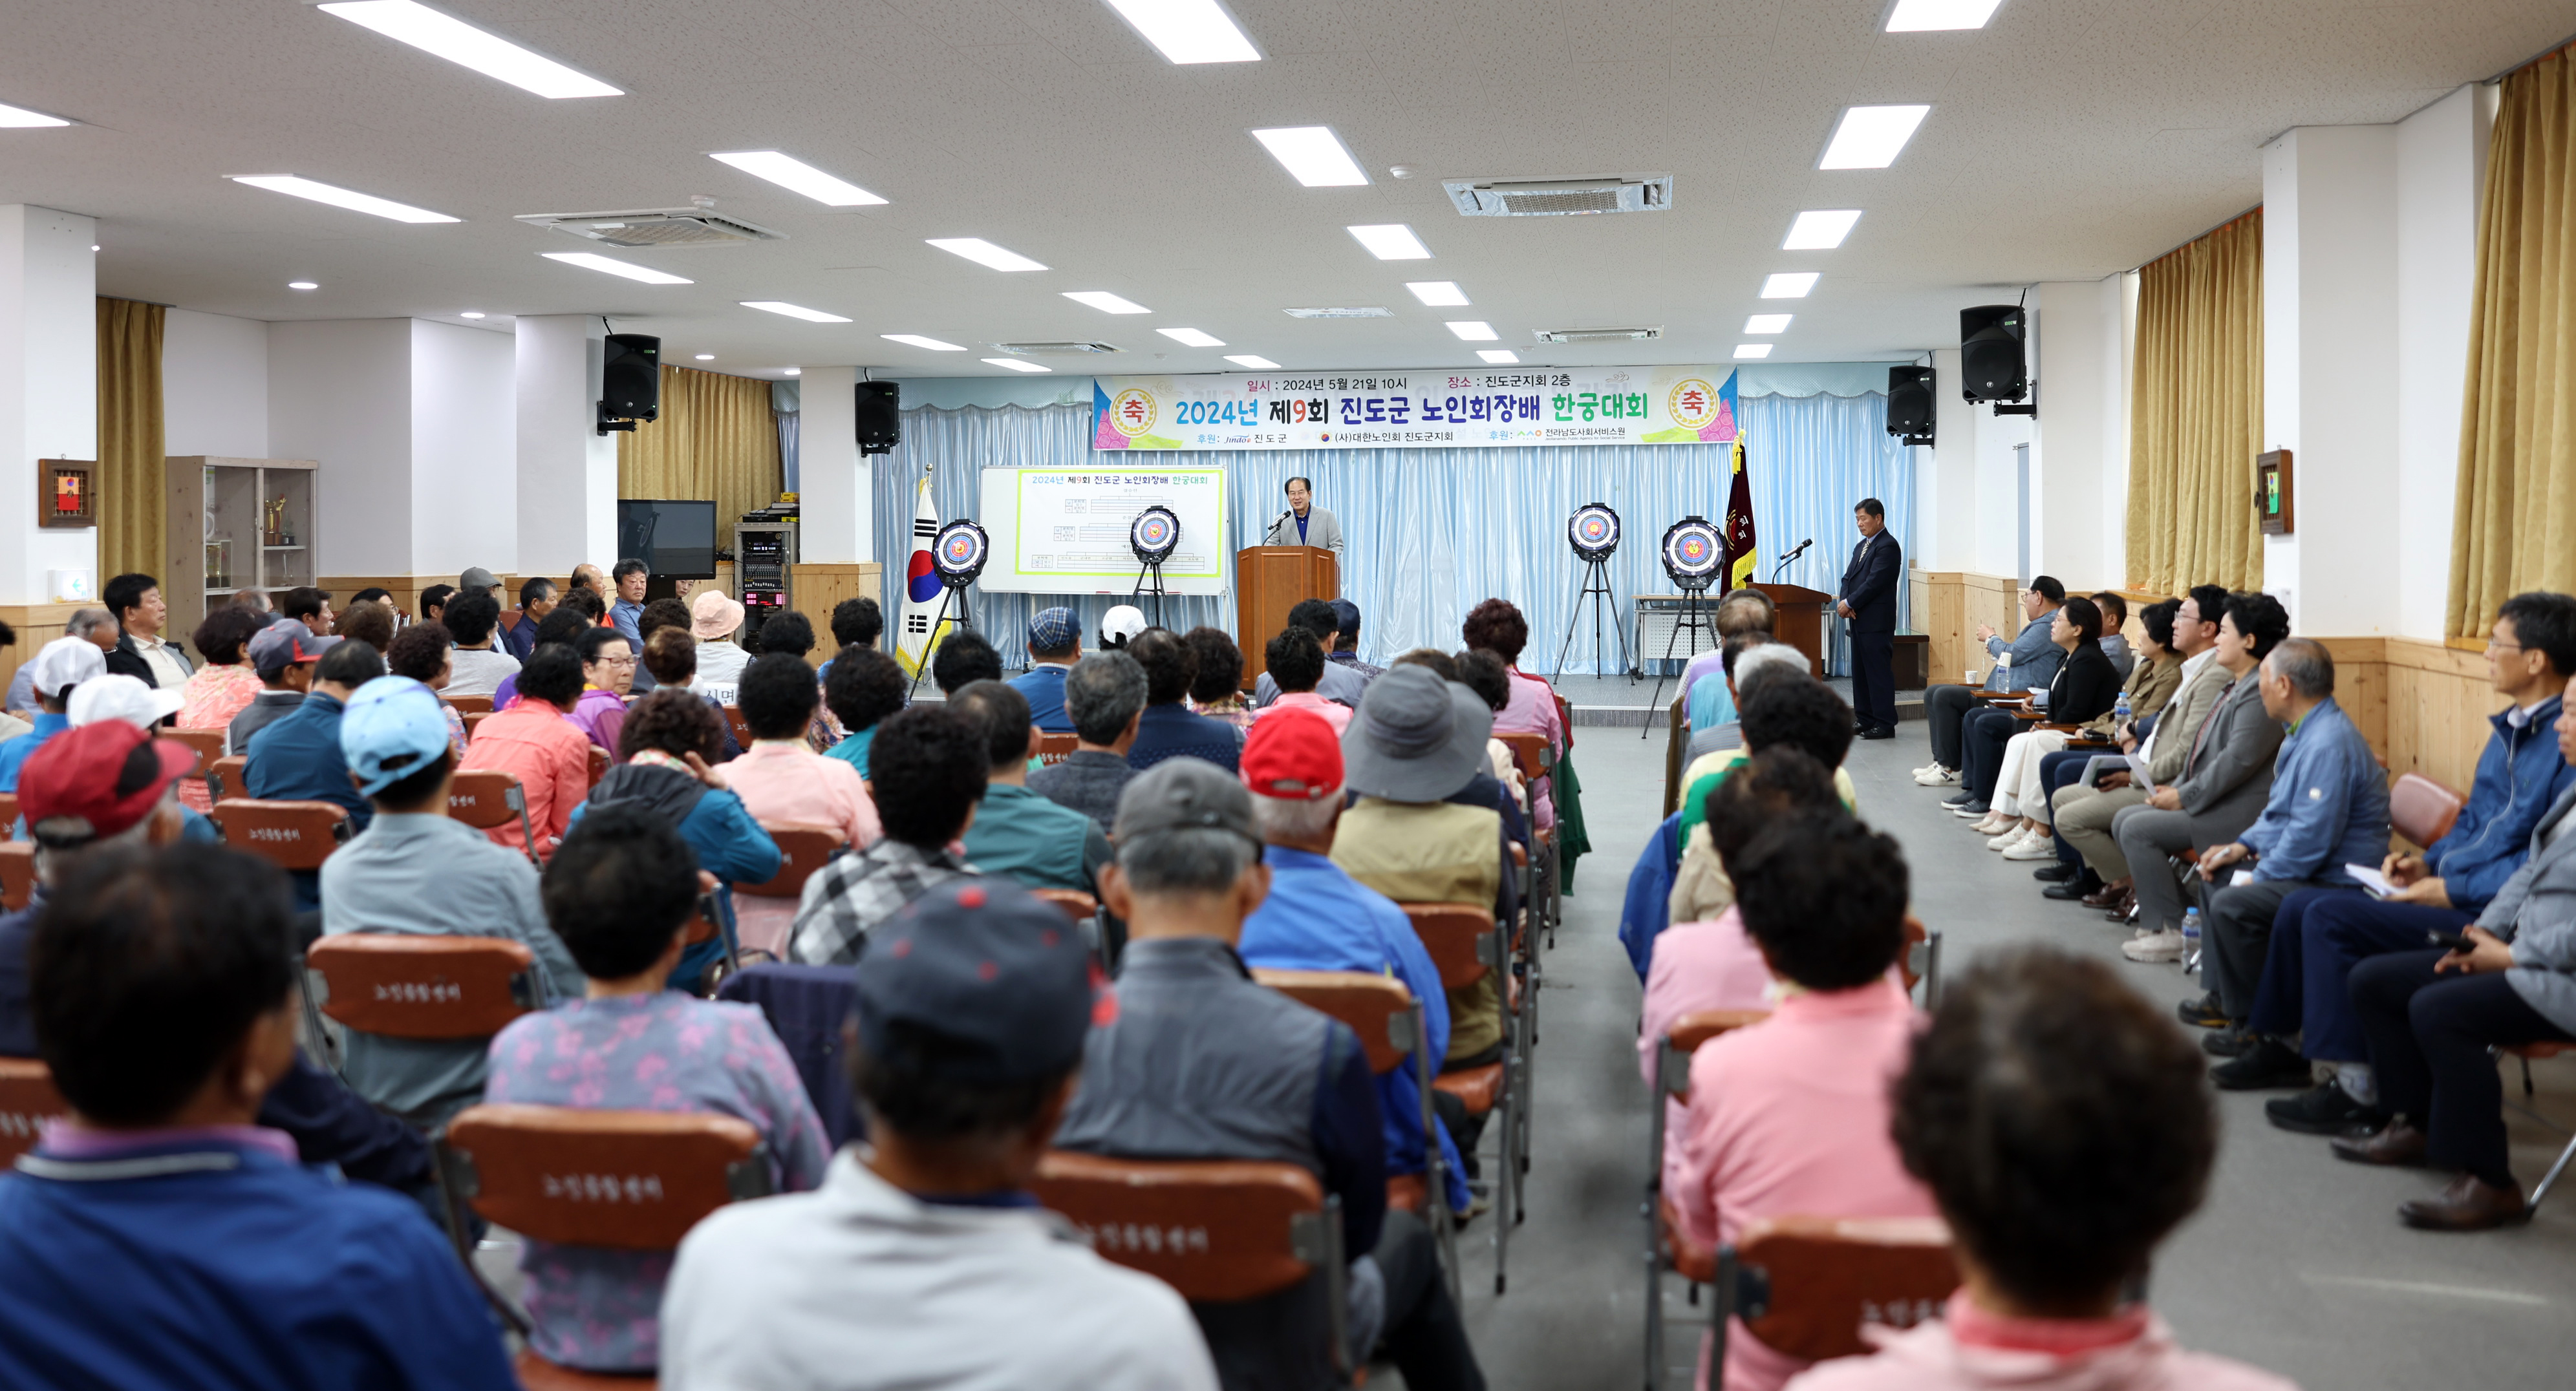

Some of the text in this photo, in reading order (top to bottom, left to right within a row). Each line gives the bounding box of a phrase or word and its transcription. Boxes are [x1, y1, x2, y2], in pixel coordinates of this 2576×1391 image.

[1248, 380, 1270, 392] 일시
[1283, 379, 1324, 390] 2024년
[1329, 378, 1347, 390] 5월
[1350, 377, 1377, 390] 21일
[1381, 377, 1407, 389] 10시
[1448, 376, 1472, 388] 장소
[1485, 375, 1547, 387] 진도군지회
[1552, 374, 1571, 387] 2층
[1680, 390, 1704, 414] 축
[1123, 399, 1145, 423] 축
[1176, 392, 1648, 426] 2024년 제9회 진도군 노인회장배 한궁대회
[1335, 432, 1401, 443] (사)대한노인회
[1404, 431, 1454, 442] 진도군지회
[1489, 430, 1513, 440] 후원:
[1545, 427, 1626, 437] 전라남도사회서비스원
[1197, 434, 1220, 443] 후원:
[1032, 476, 1208, 485] 2024년 제9회 진도군 노인회장배 한궁대회
